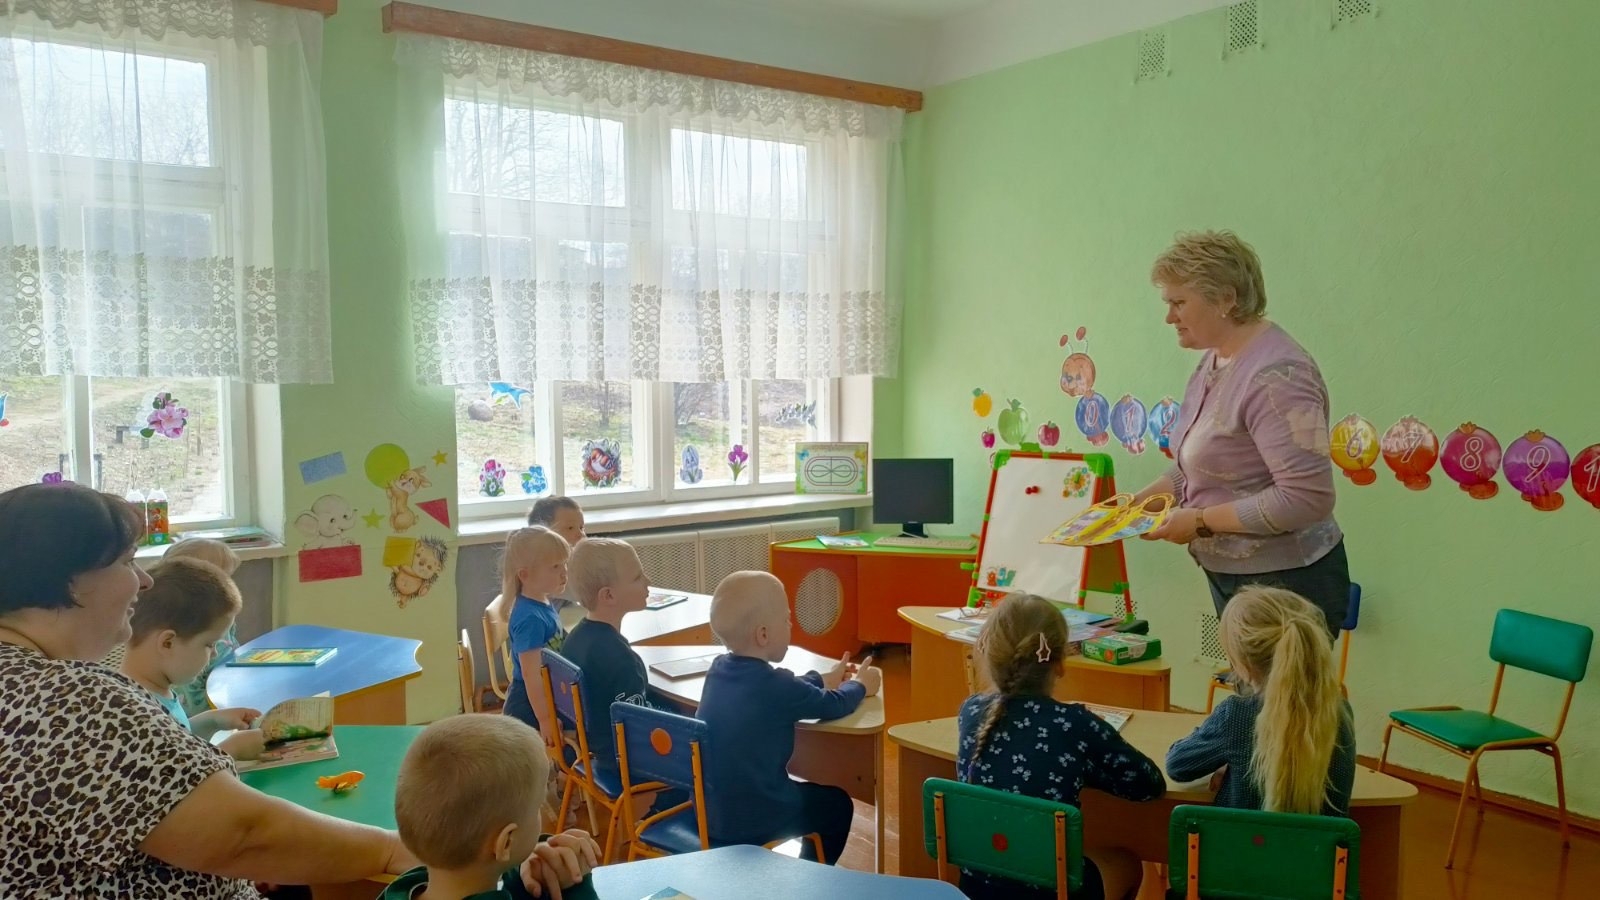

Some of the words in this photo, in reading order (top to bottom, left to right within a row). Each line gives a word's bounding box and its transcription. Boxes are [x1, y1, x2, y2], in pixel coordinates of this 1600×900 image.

[1085, 401, 1099, 427] 0
[1160, 410, 1176, 435] 2
[1346, 429, 1363, 459] 6
[1401, 432, 1425, 463] 7
[1460, 437, 1484, 472] 8
[1524, 445, 1551, 483] 9
